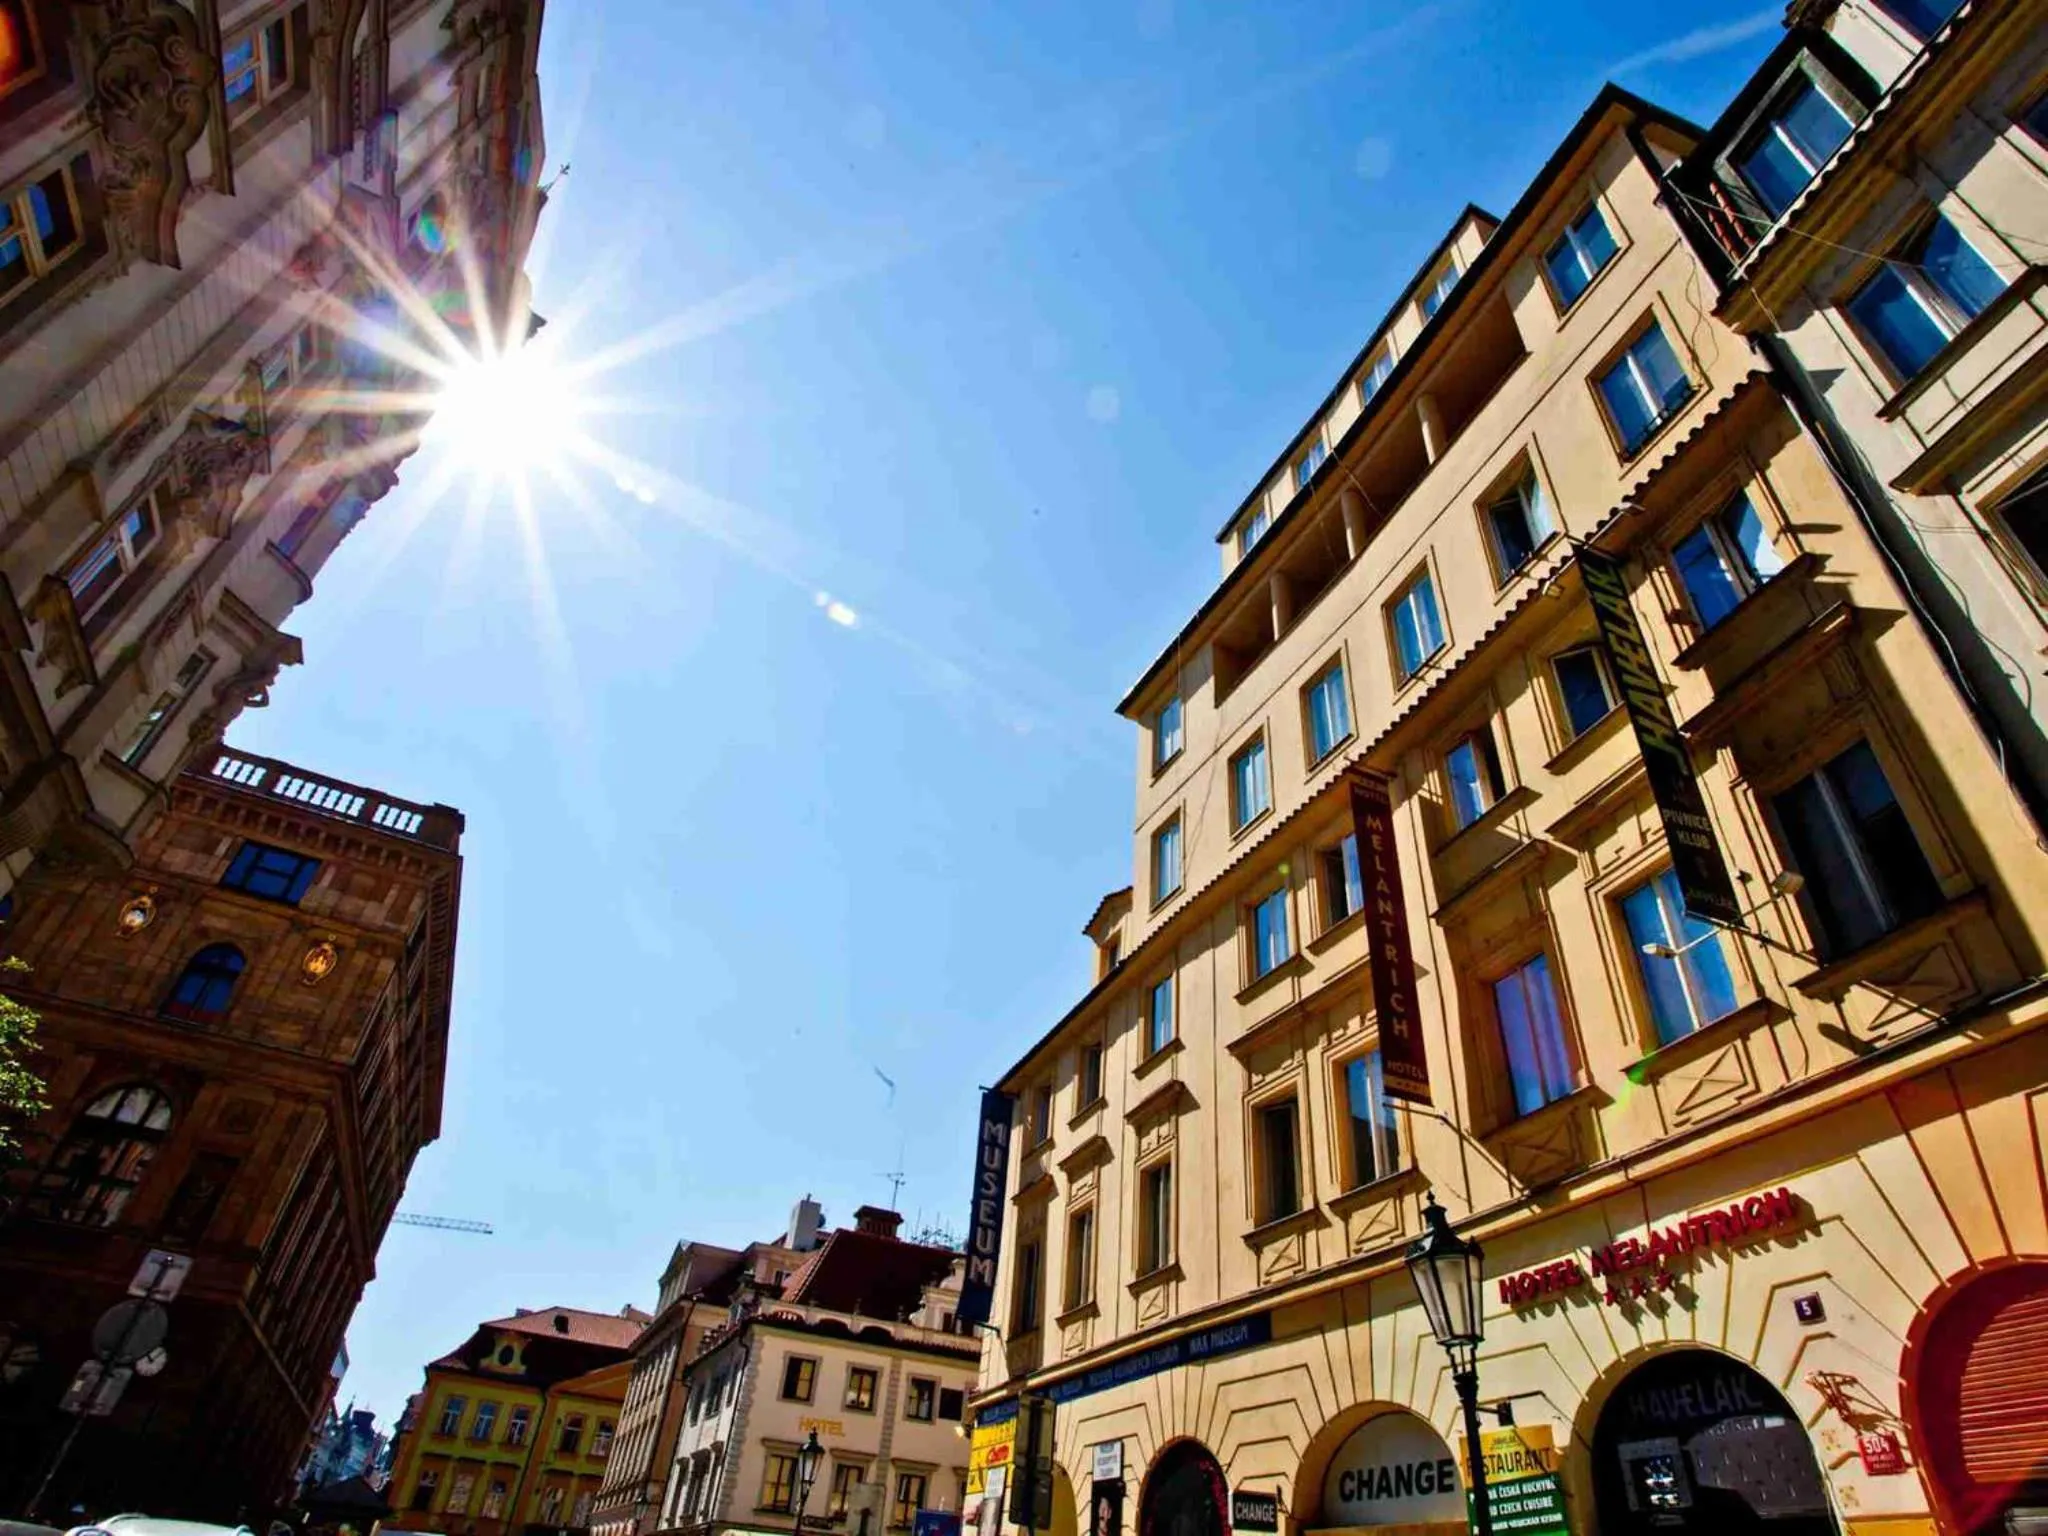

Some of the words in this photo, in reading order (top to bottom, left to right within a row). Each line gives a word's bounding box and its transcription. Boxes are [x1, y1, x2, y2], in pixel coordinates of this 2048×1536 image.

[1365, 813, 1408, 1040] MELANTRICH
[969, 1119, 1008, 1287] MUSEUM
[1498, 1258, 1584, 1304] HOTEL
[1591, 1186, 1796, 1278] MELANTRICH
[1801, 1300, 1812, 1316] 5
[797, 1416, 845, 1438] HOTEL
[1863, 1436, 1890, 1454] 504
[1338, 1458, 1456, 1503] CHANGE
[1235, 1502, 1274, 1522] CHANGE
